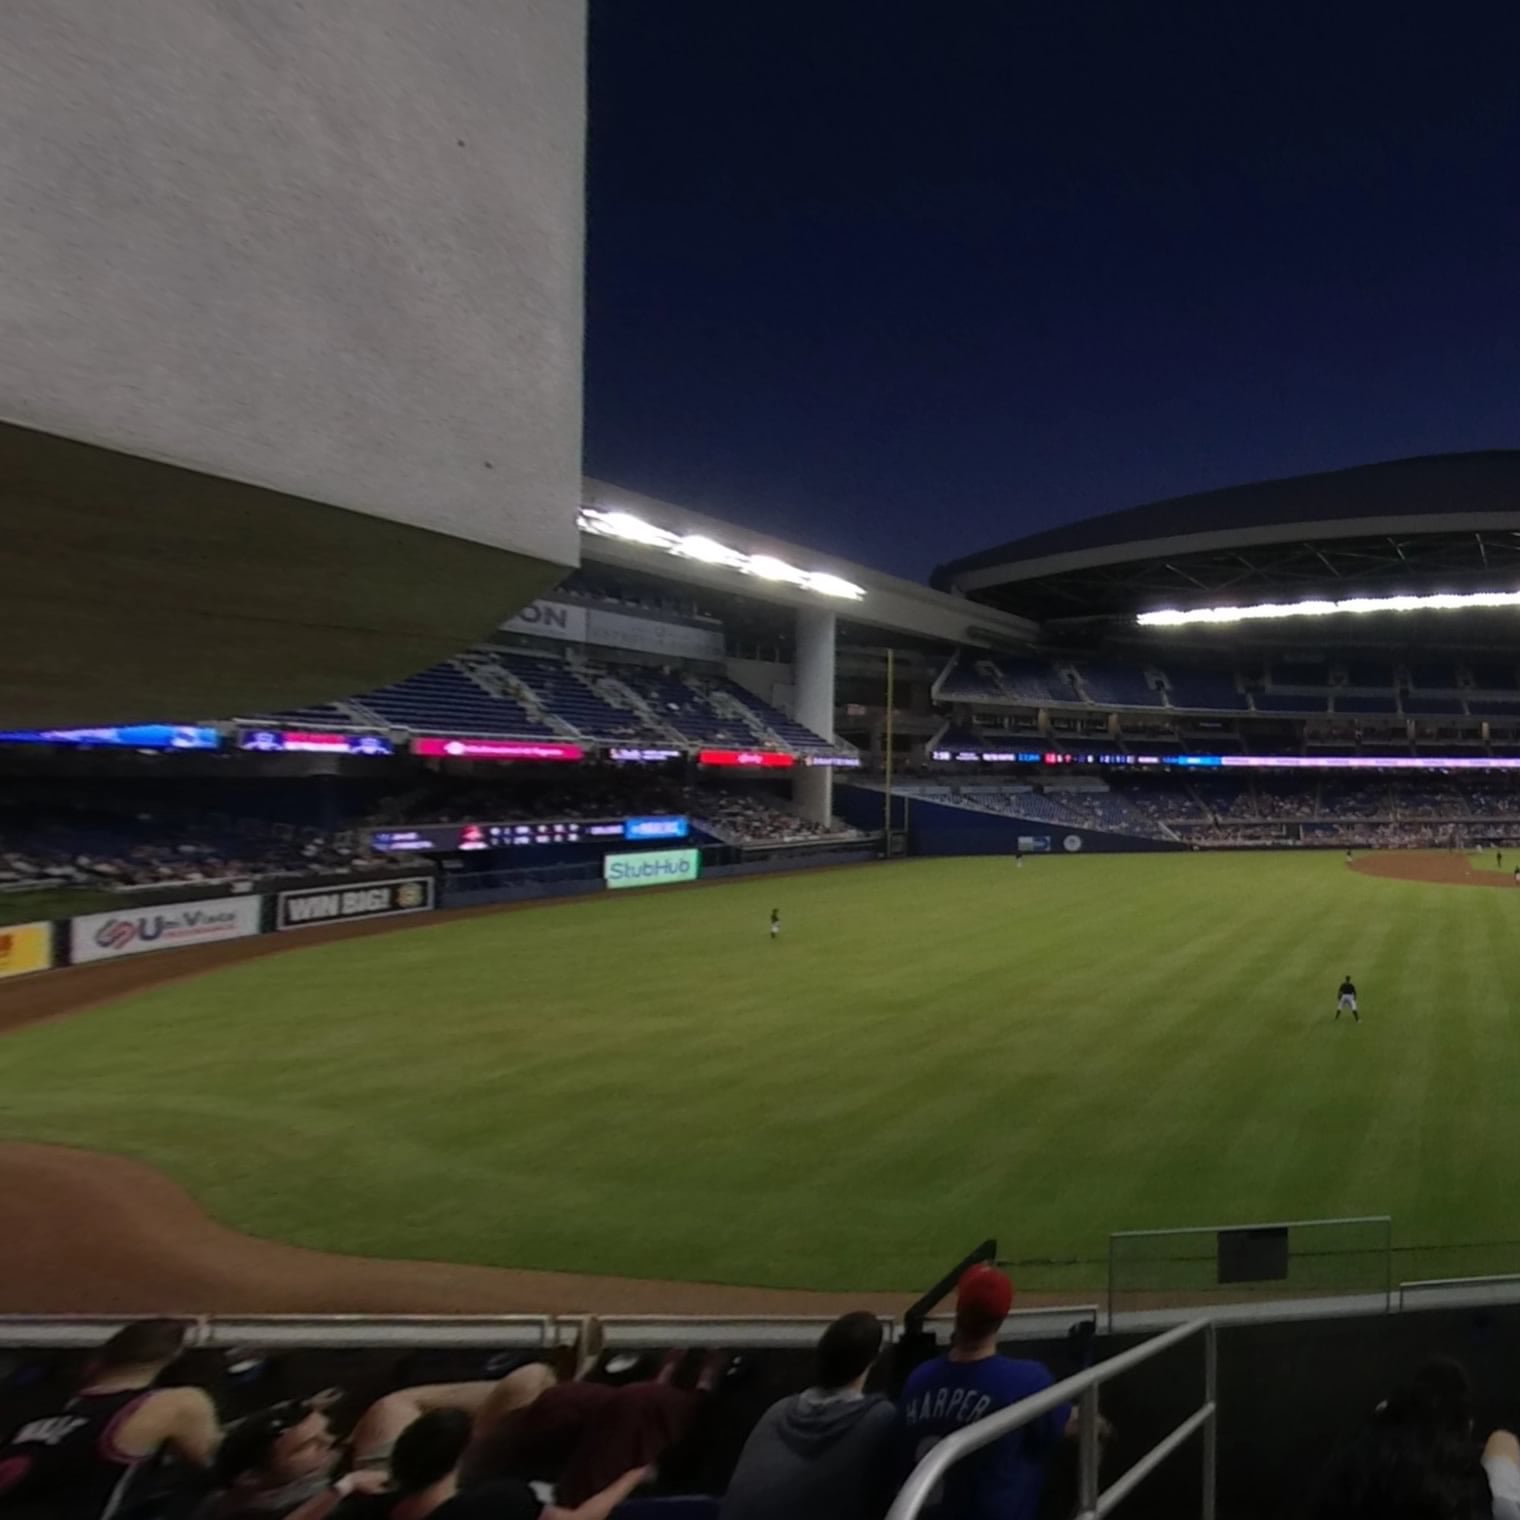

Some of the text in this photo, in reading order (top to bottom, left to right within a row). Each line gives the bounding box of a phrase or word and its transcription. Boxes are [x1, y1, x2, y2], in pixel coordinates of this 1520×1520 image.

[607, 859, 691, 881] StubHub
[289, 888, 390, 921] WIN BIG!
[905, 1387, 993, 1425] HARPER
